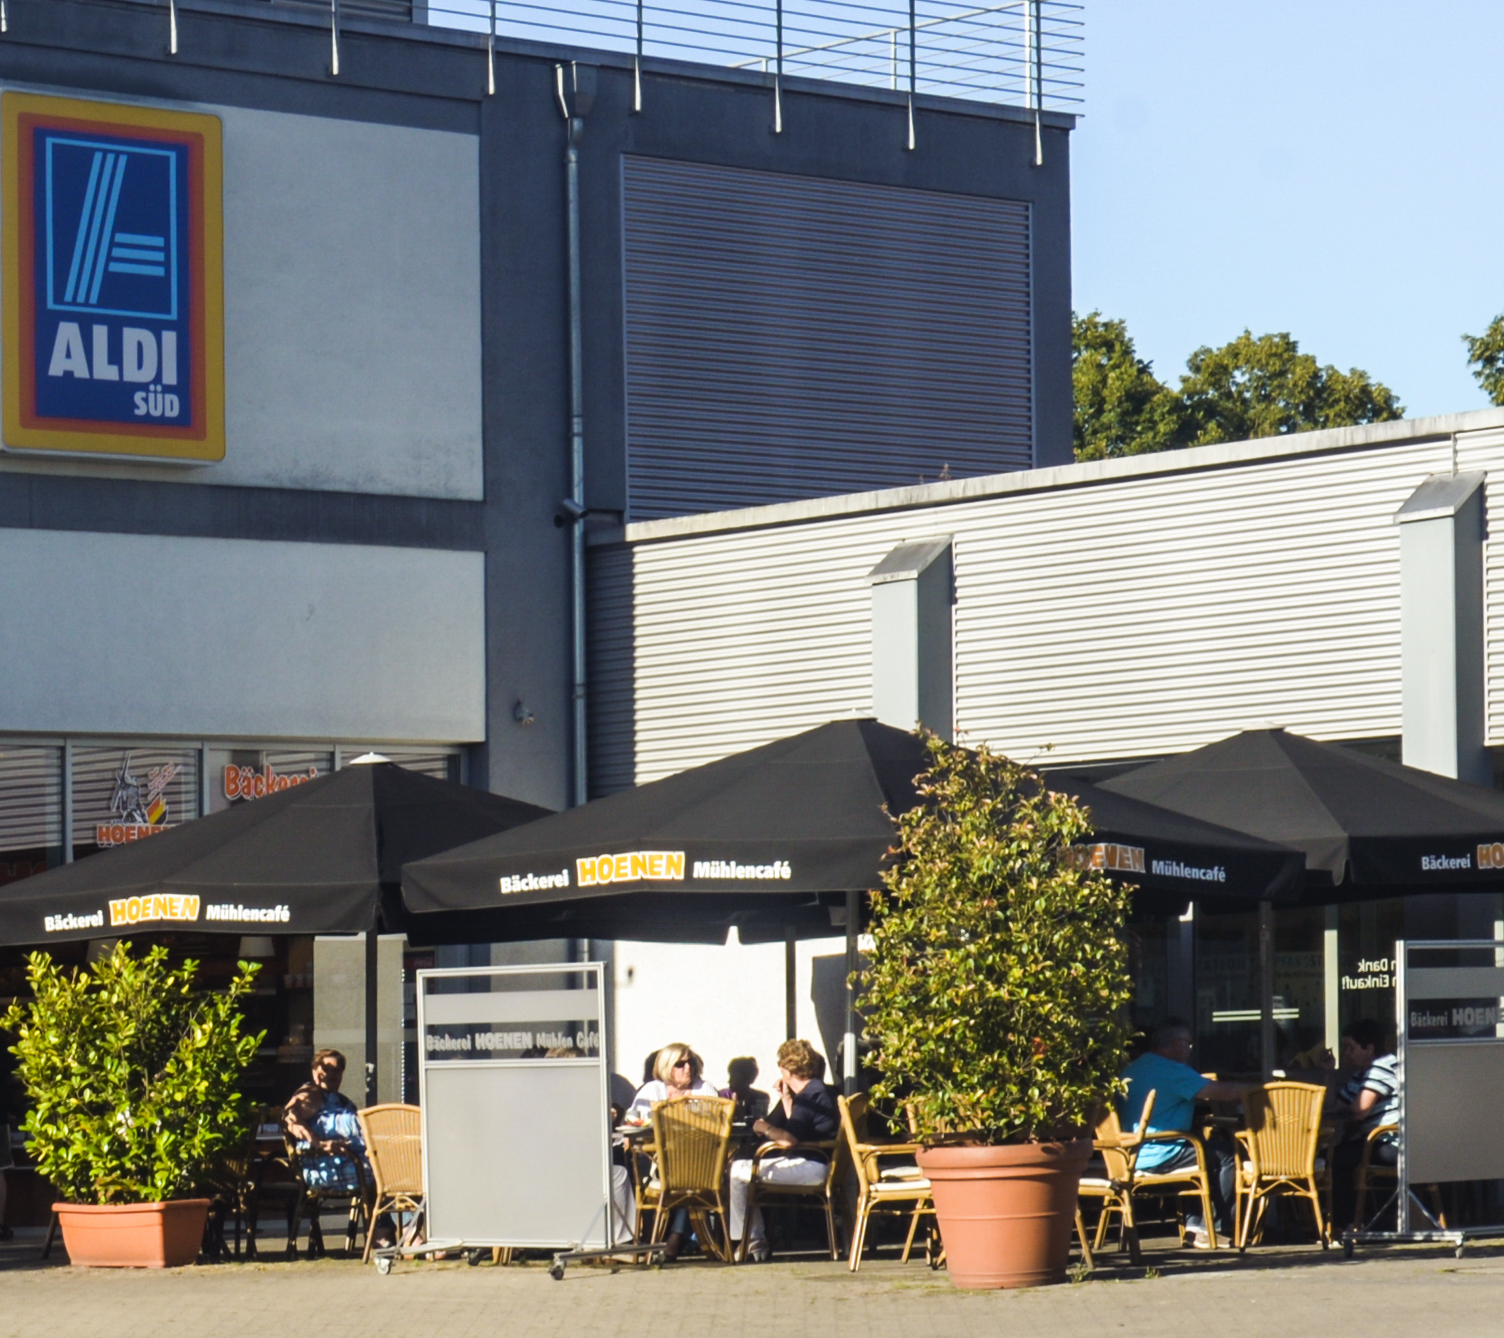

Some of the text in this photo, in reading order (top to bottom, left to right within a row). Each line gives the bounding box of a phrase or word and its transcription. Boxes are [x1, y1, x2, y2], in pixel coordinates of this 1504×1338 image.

[48, 321, 178, 386] ALDI
[133, 383, 180, 418] SÜD
[500, 851, 791, 894] Bäckerei HOENEN Mühlencafé
[1152, 859, 1226, 882] Mühlencafé
[1421, 854, 1471, 870] Bäckerei
[45, 894, 290, 932] Bäckerei HOENEN Mühlencafé
[1410, 1010, 1448, 1028] Bäckerei
[426, 1034, 471, 1051] Bäckerei
[475, 1032, 532, 1050] HOENEN
[536, 1031, 573, 1048] Mühlen
